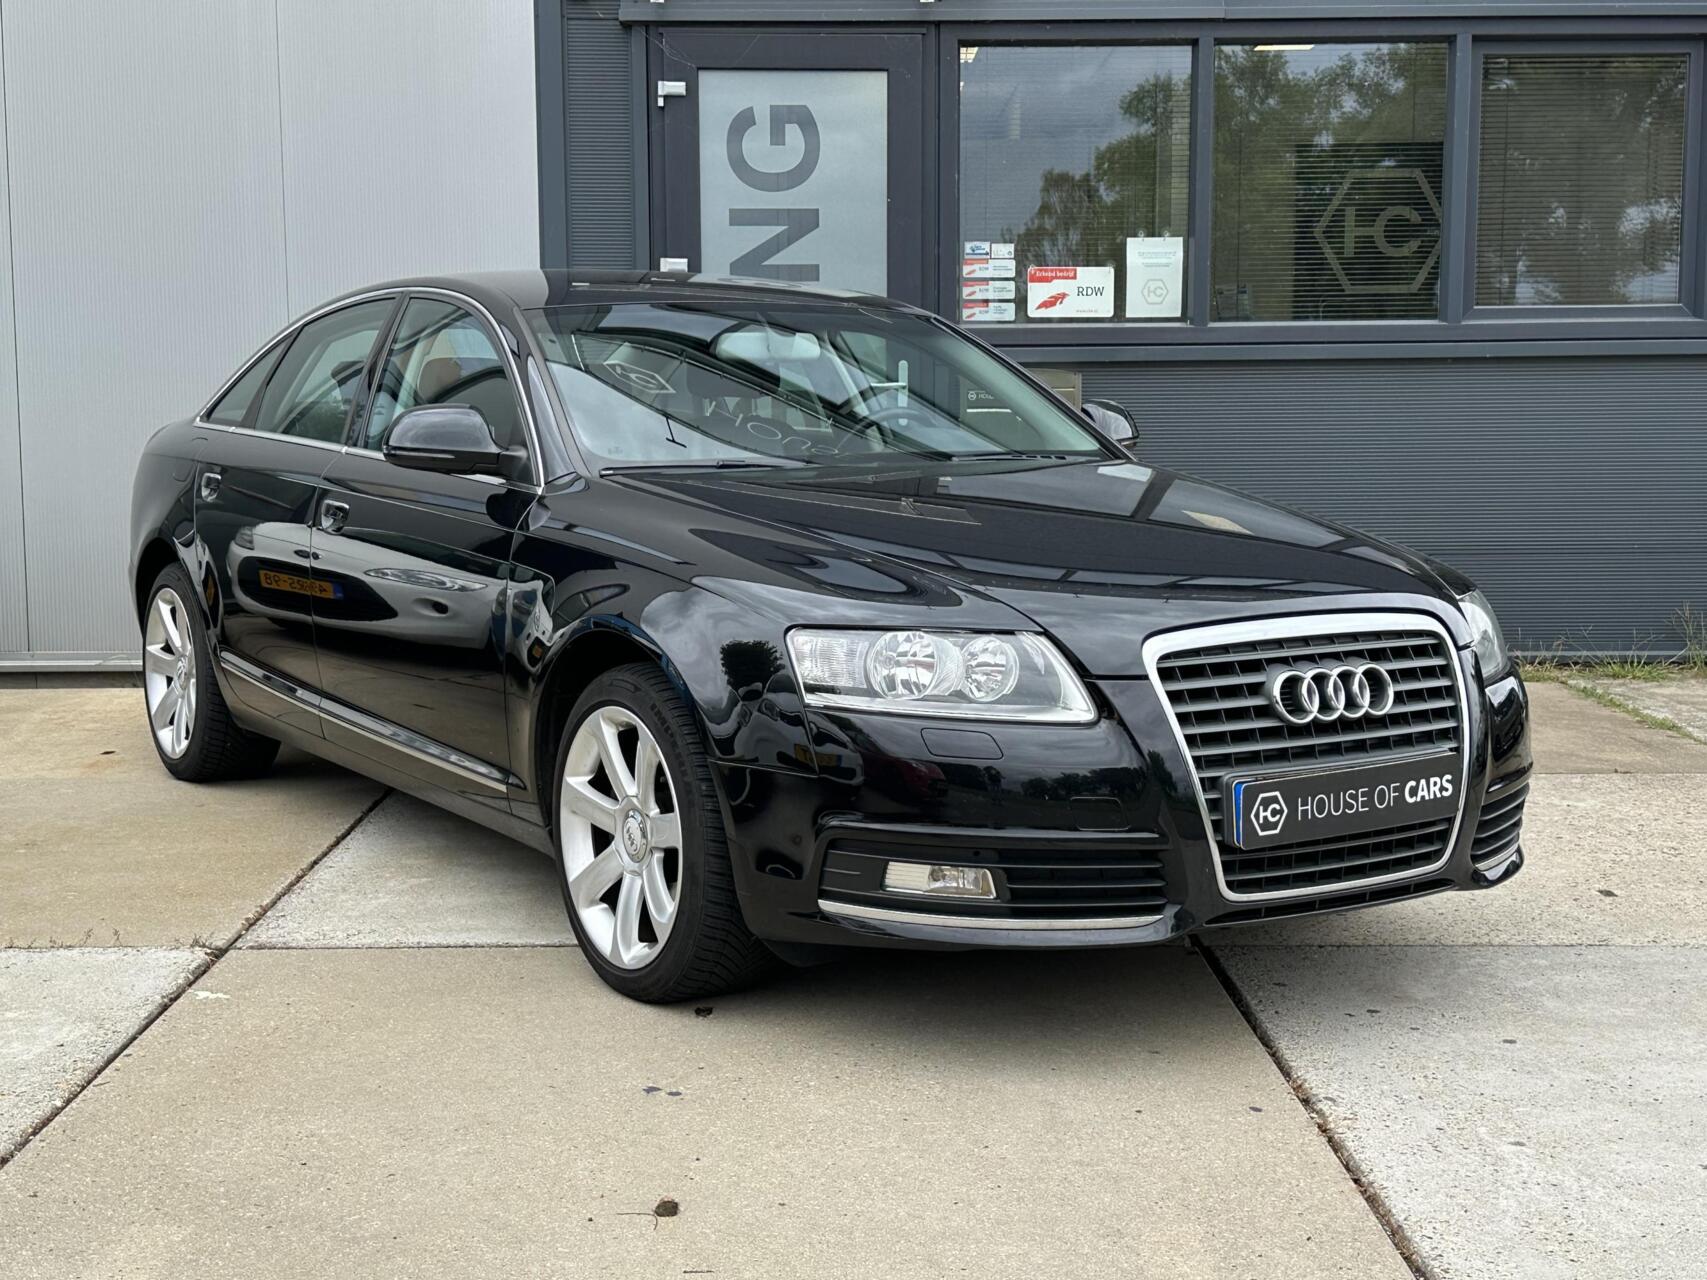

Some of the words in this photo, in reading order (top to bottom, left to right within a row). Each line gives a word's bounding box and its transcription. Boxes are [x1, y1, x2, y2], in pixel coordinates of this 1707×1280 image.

[1076, 286, 1105, 297] RDW
[1298, 788, 1369, 821] HOUSE
[1374, 783, 1401, 809] OF
[1404, 774, 1454, 804] CARS
